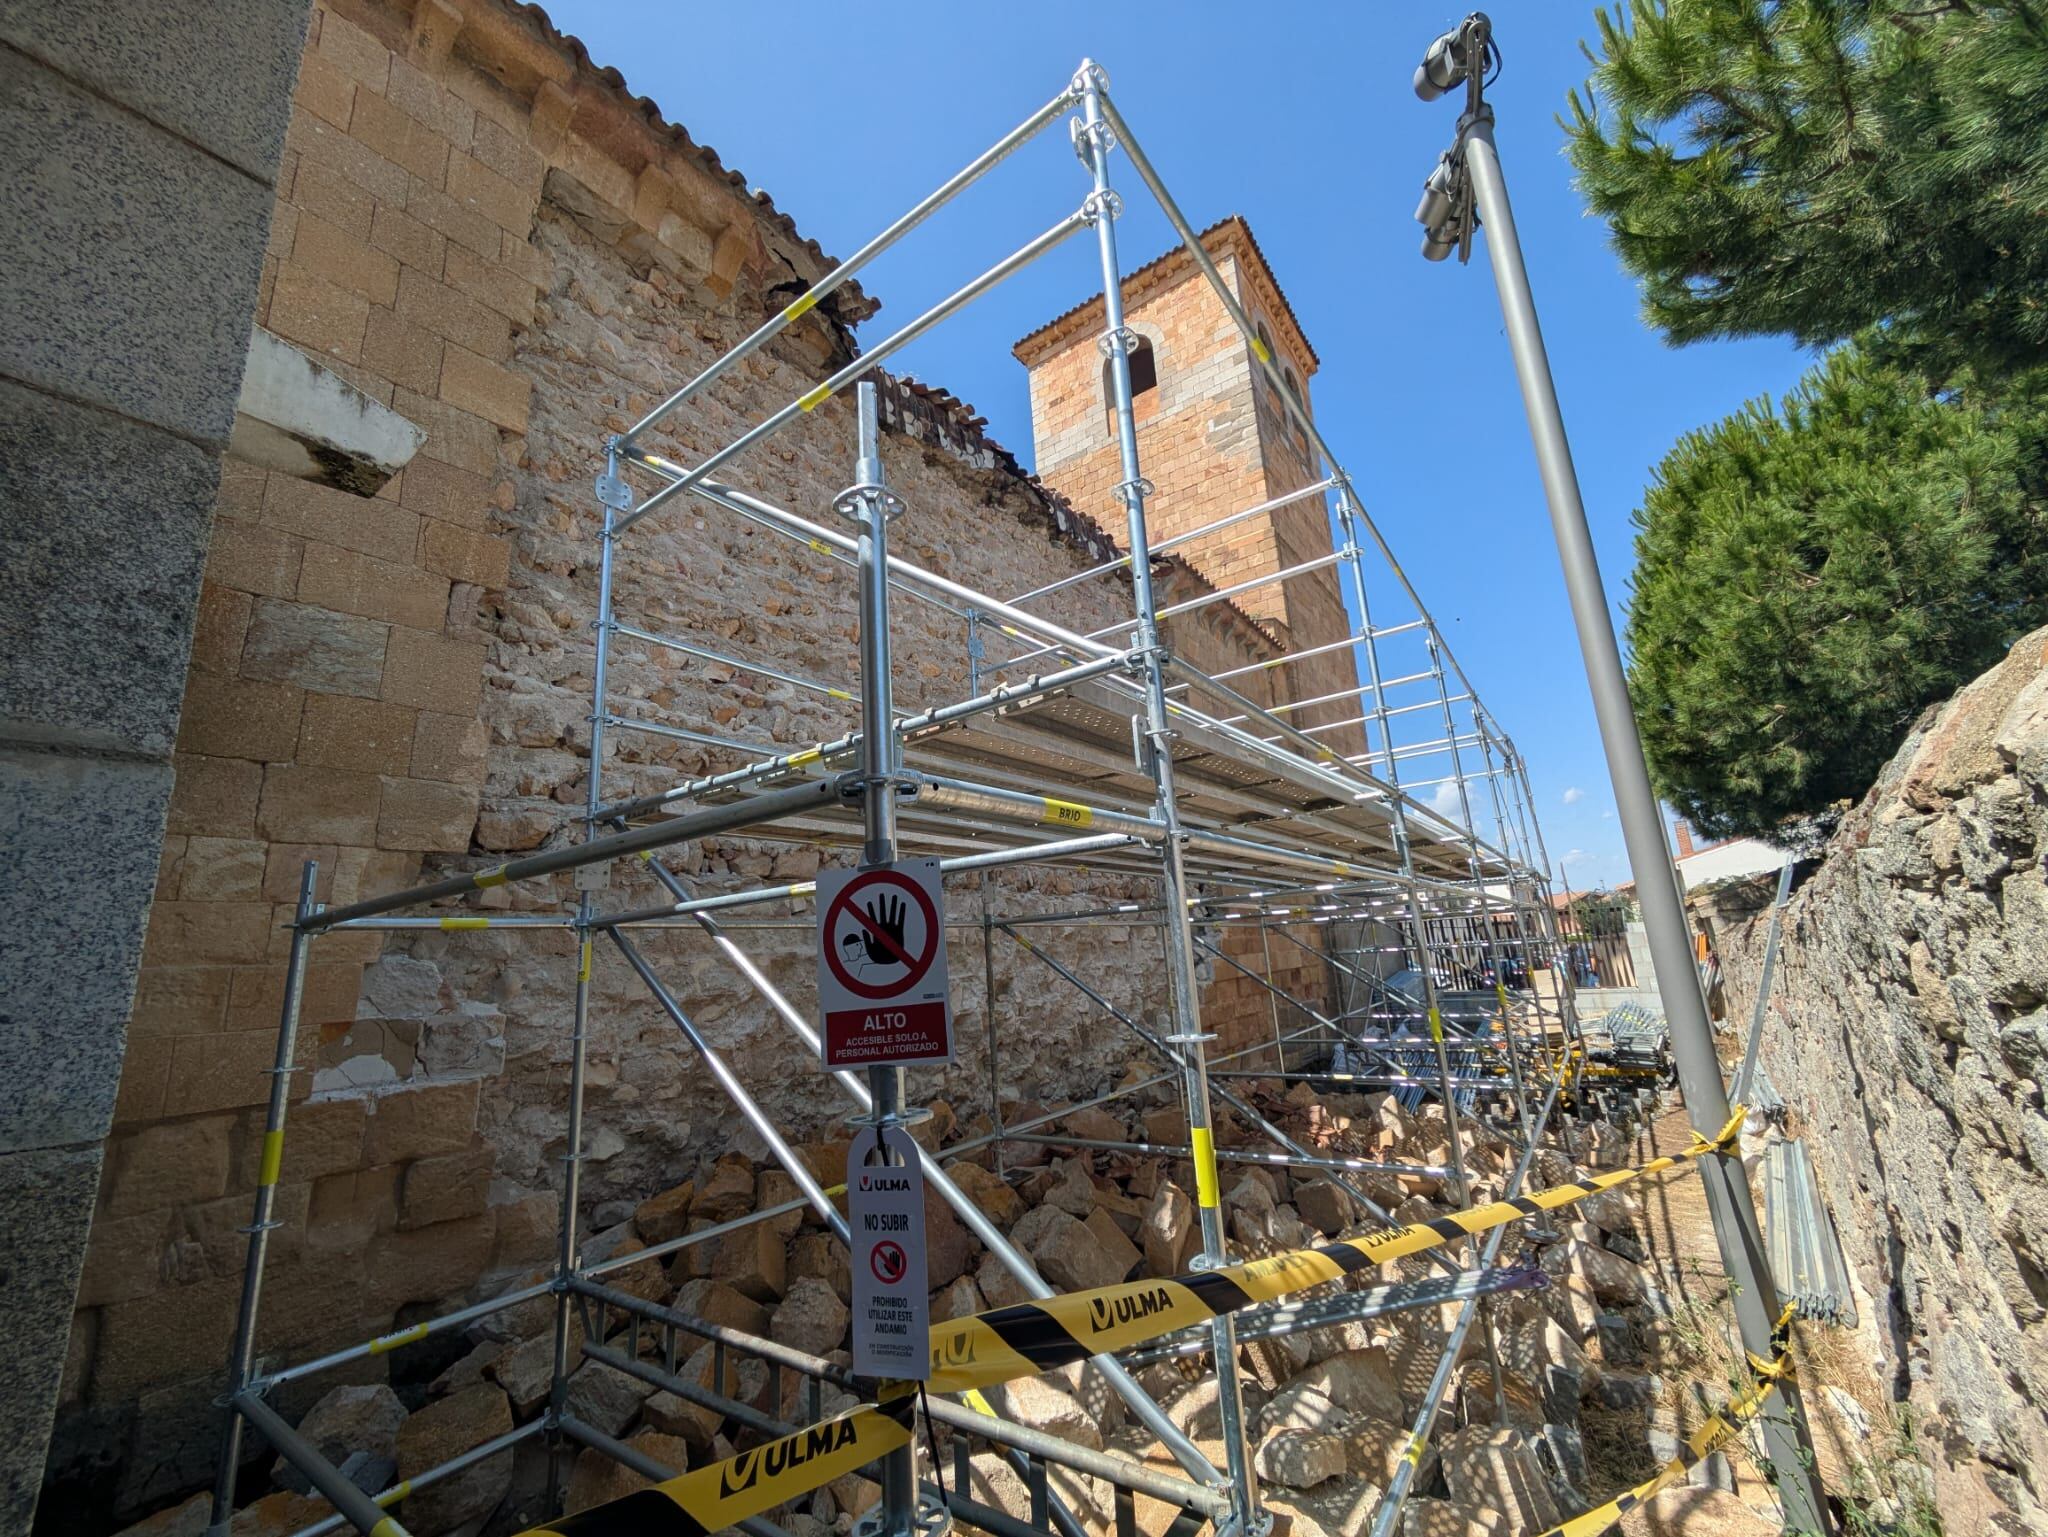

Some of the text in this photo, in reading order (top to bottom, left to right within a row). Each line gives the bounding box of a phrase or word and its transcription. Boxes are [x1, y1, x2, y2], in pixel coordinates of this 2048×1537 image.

[1059, 807, 1081, 822] BRIO
[864, 1012, 907, 1031] ALTO
[846, 1032, 928, 1047] ACCESIBLE SOLO A
[836, 1042, 939, 1058] PERSONAL AUTORIZADO
[874, 1179, 911, 1192] ULMA
[864, 1214, 909, 1231] NO SUBIR
[872, 1296, 908, 1308] PROHIBIDO
[1114, 1287, 1174, 1323] ULMA
[868, 1309, 913, 1323] UTILIZAR ESTE
[874, 1323, 907, 1336] ANDAMIO
[764, 1417, 857, 1477] ULMA
